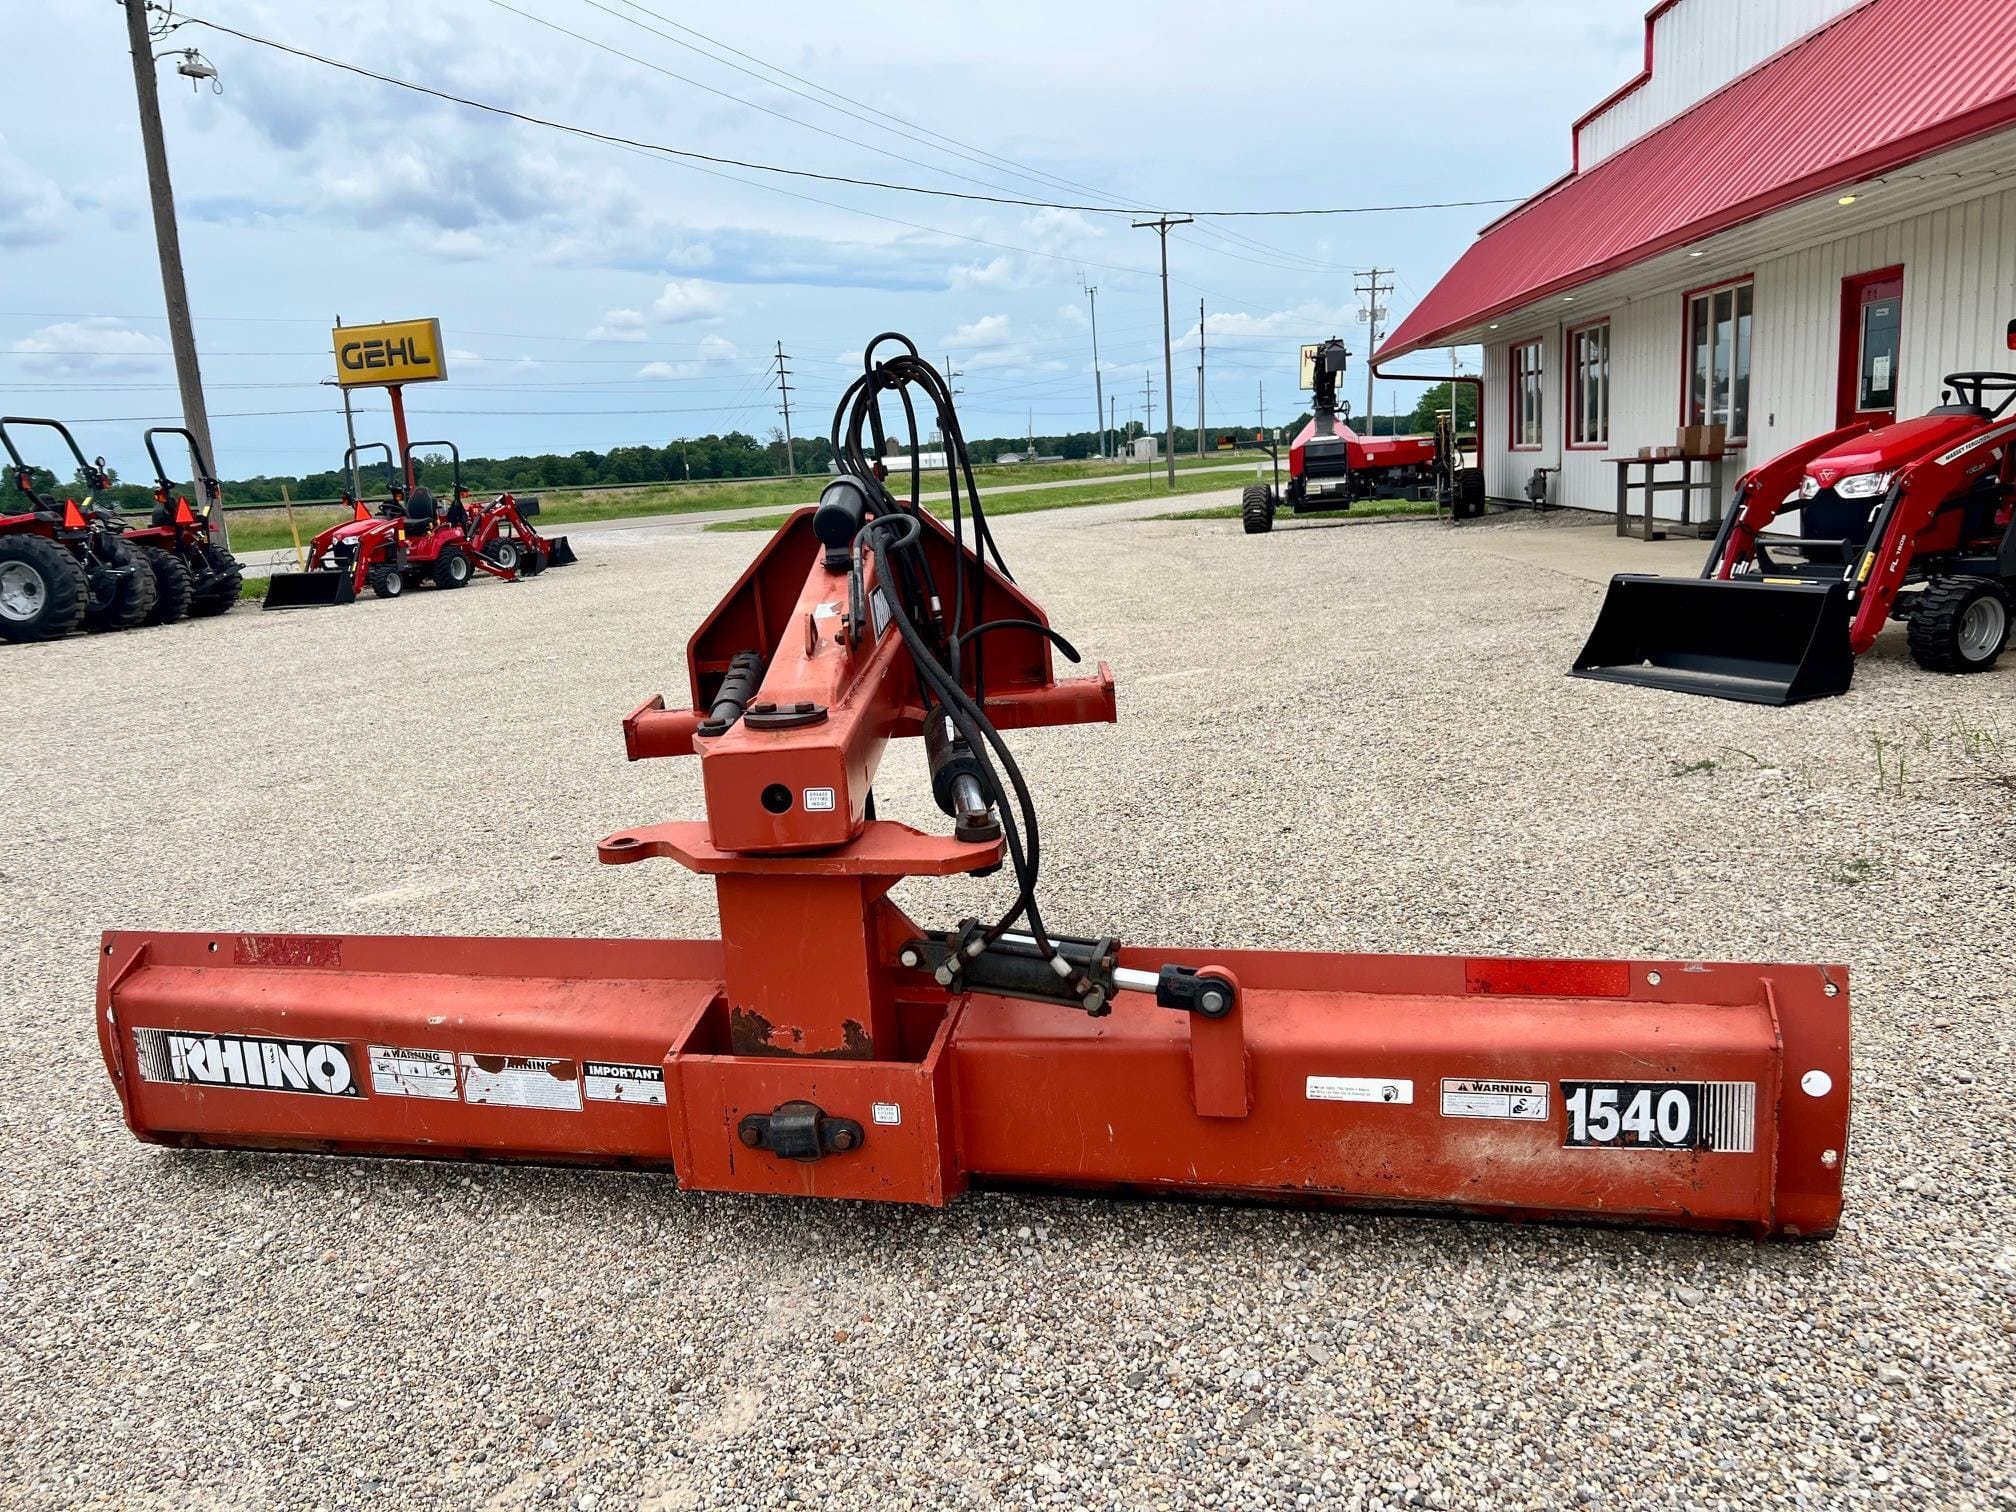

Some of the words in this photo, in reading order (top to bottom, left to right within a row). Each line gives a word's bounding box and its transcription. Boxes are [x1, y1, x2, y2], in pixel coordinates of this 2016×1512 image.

[341, 336, 431, 370] GEHL
[1945, 447, 1965, 460] MASSEY
[1965, 435, 1991, 450] FERGUSON
[1889, 558, 1899, 573] FL
[167, 1035, 351, 1094] RHINO
[391, 1049, 440, 1061] WARNING
[588, 1065, 660, 1080] IMPORTANT
[1472, 1082, 1533, 1094] WARNING
[1565, 1087, 1691, 1143] 1540
